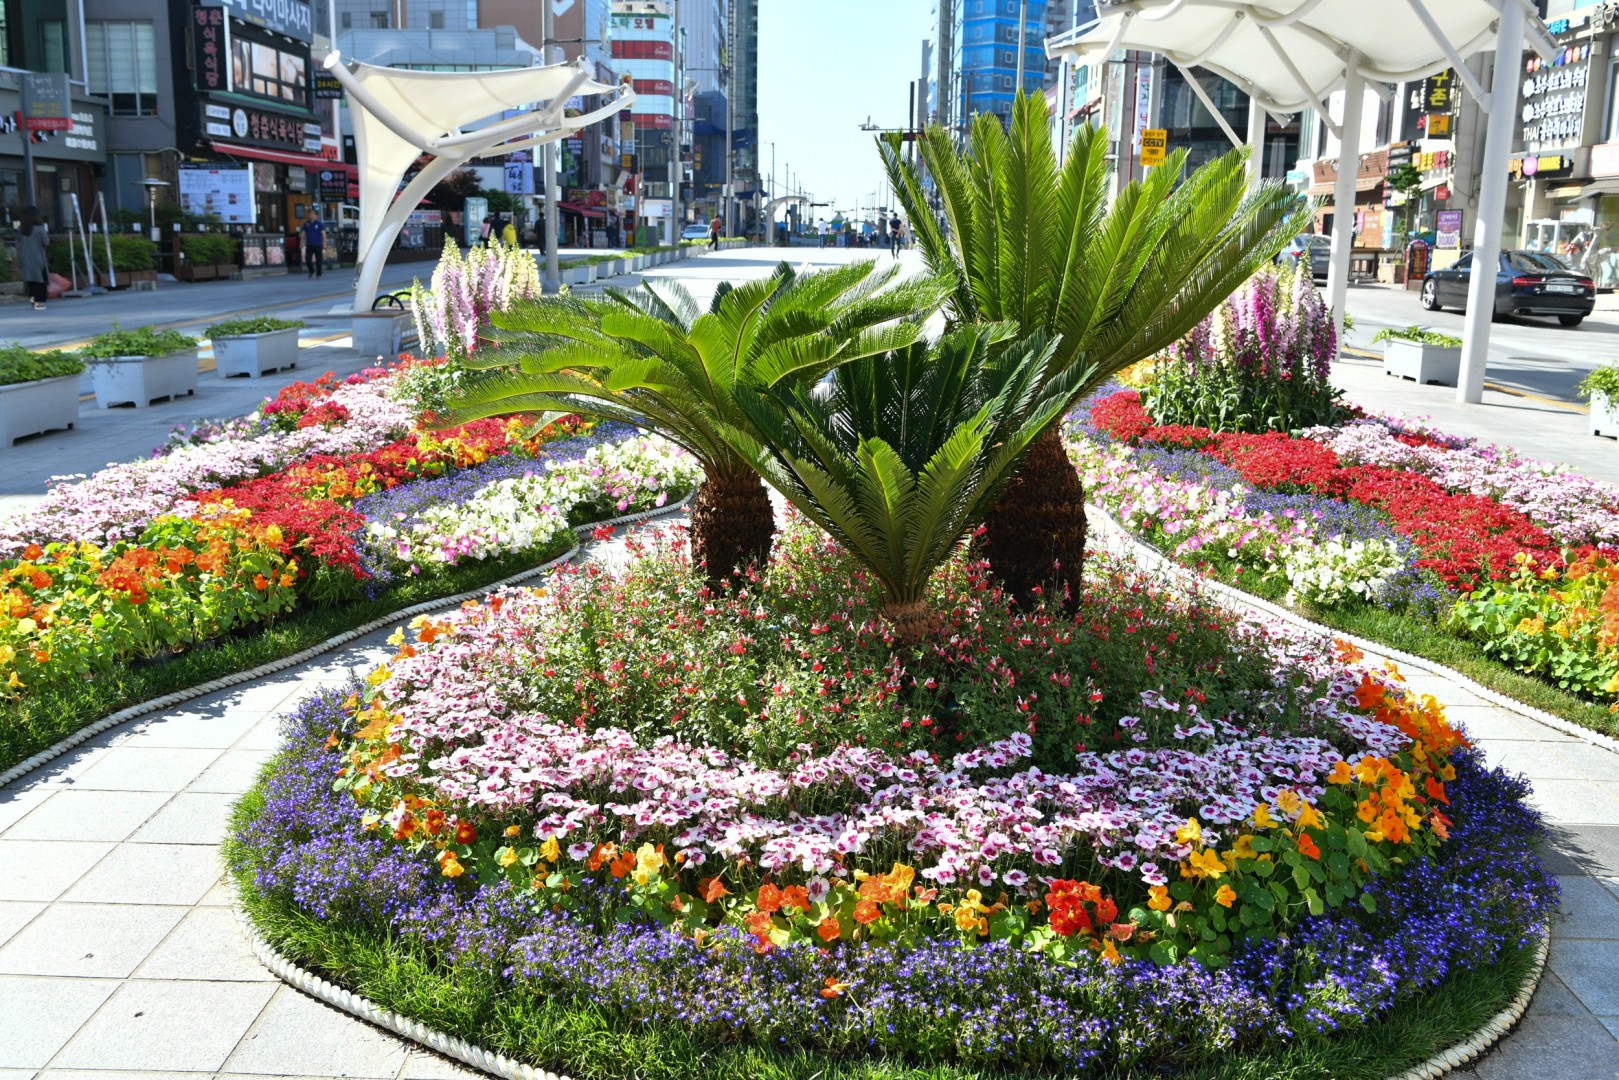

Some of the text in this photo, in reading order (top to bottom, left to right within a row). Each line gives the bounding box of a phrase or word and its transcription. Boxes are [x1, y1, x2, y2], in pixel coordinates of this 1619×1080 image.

[1523, 126, 1540, 141] THAI
[1144, 139, 1164, 147] CCTV
[635, 226, 649, 249] 4
